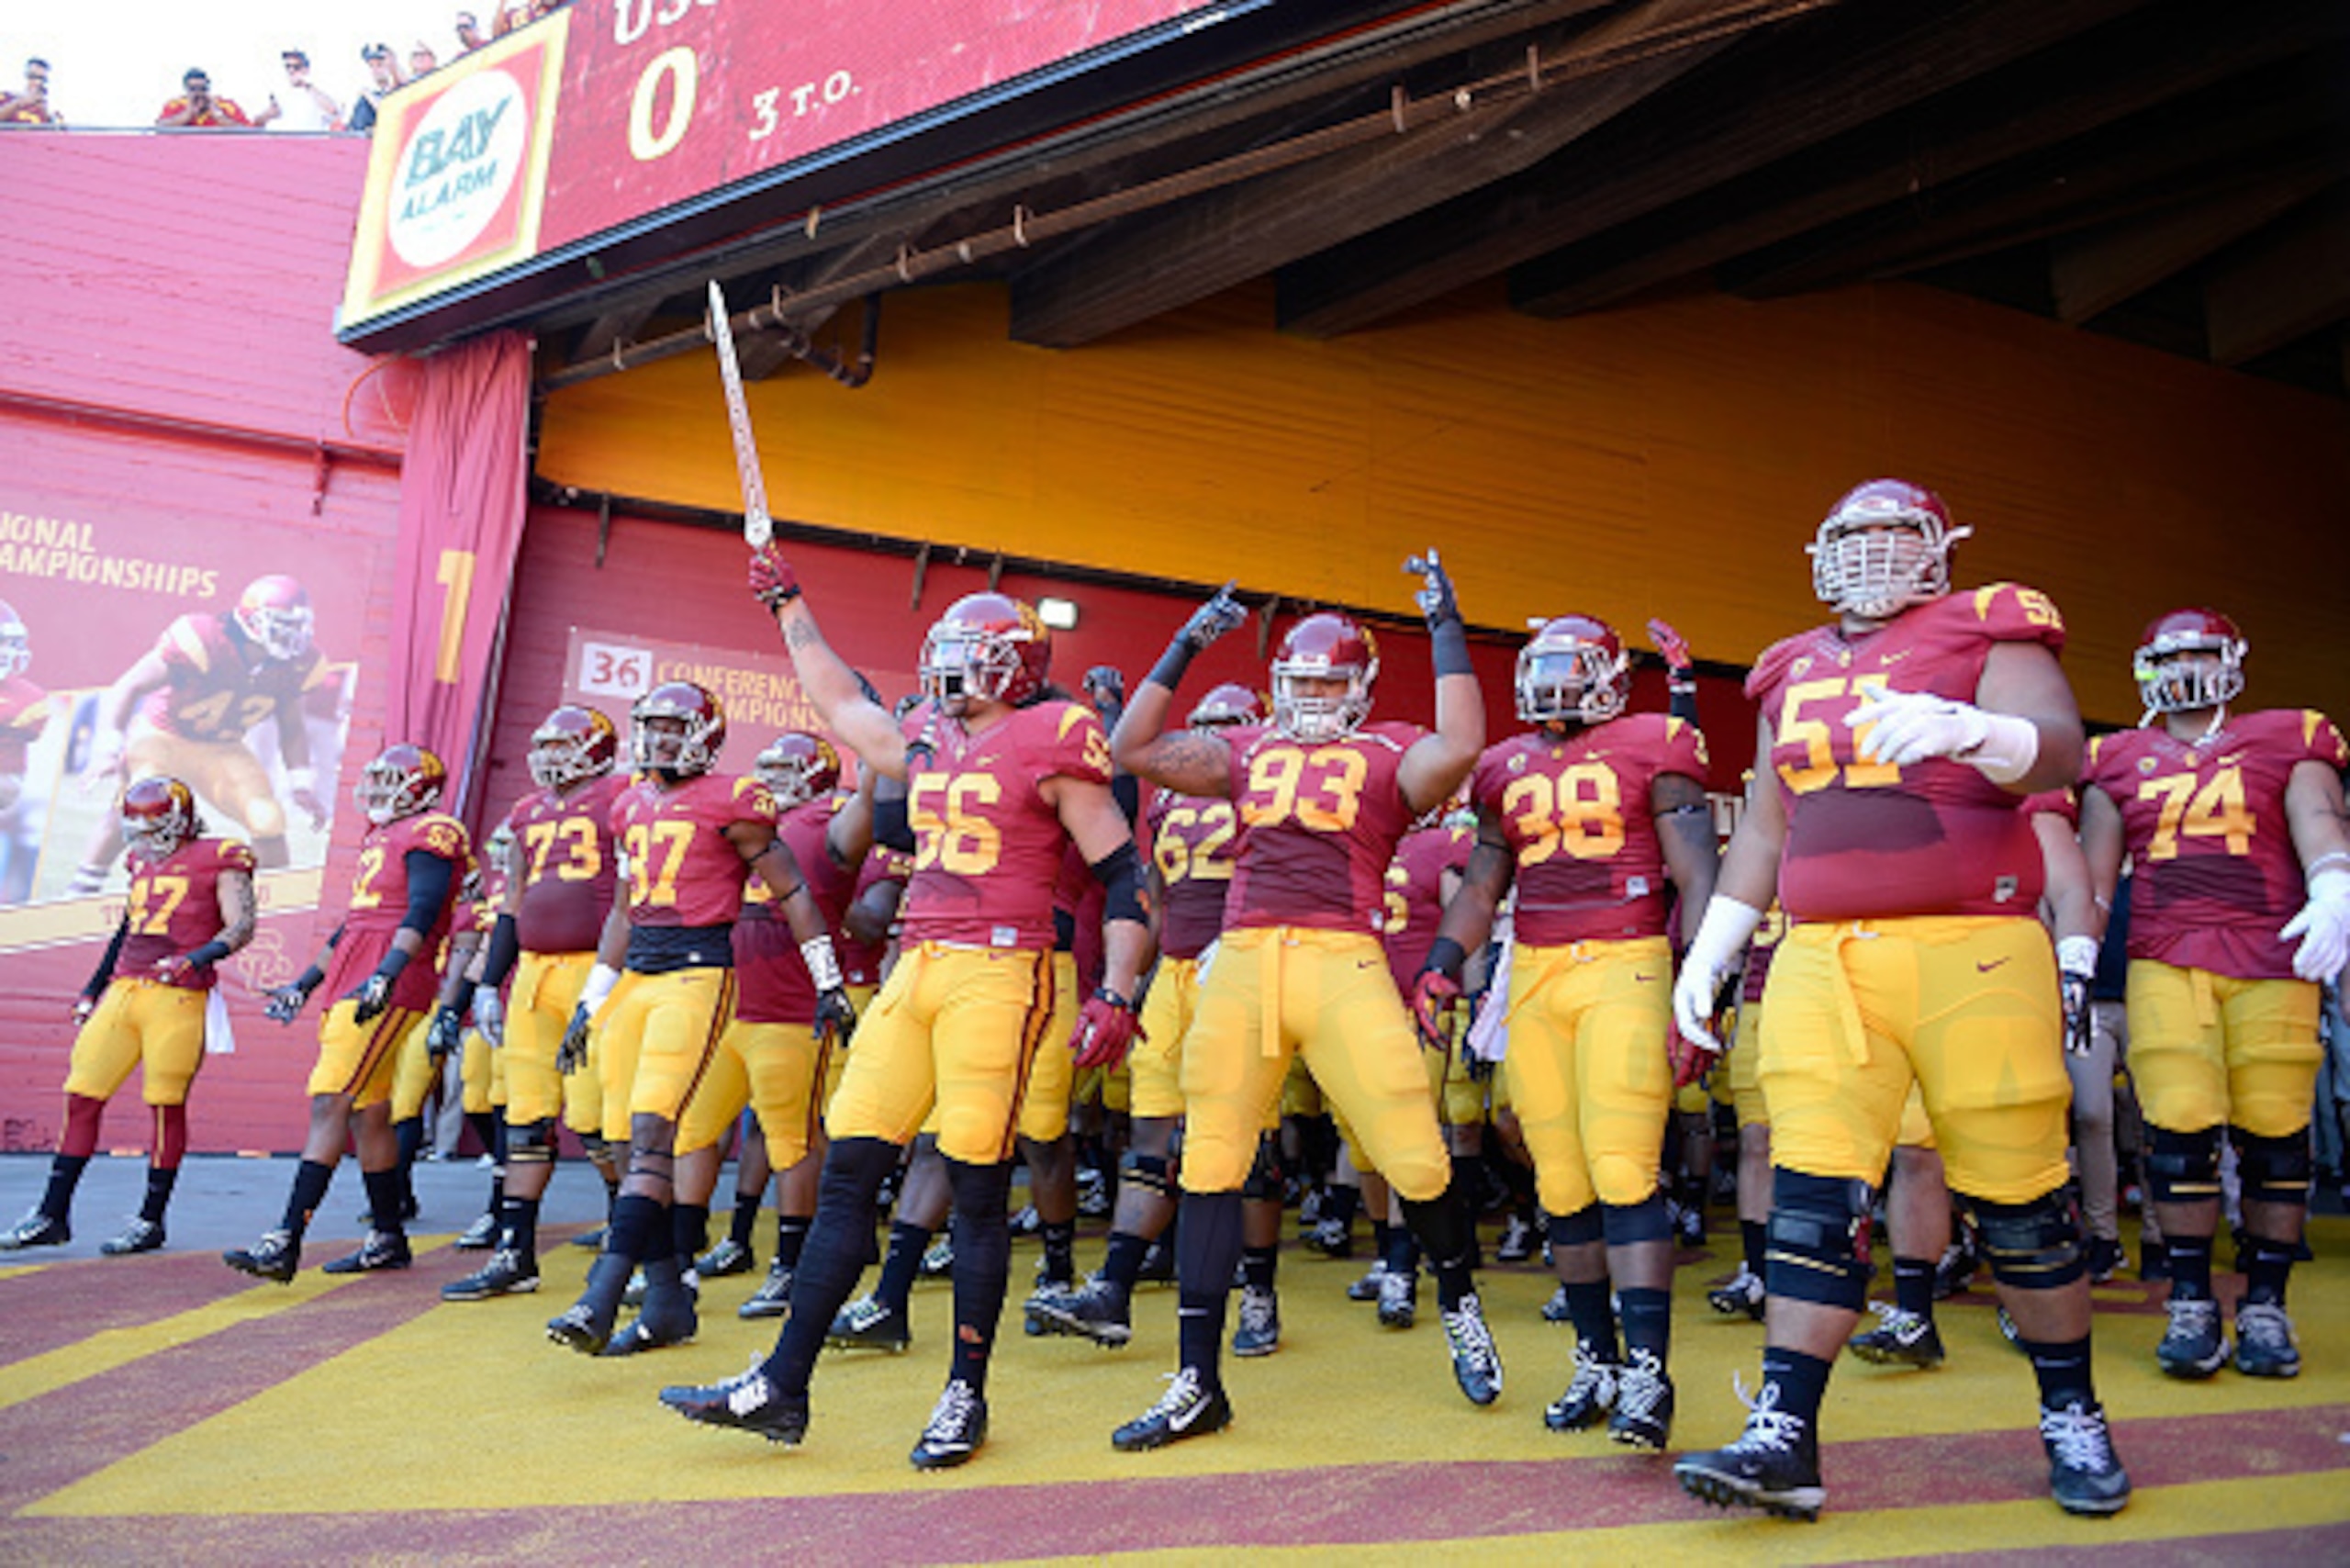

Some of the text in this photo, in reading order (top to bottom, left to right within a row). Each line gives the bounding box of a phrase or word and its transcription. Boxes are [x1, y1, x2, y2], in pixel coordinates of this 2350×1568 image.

[404, 95, 512, 188] BAY
[628, 46, 699, 162] 0
[749, 86, 779, 140] 3
[398, 158, 499, 222] ALARM
[591, 651, 641, 688] 36
[1776, 671, 1903, 795] 51
[908, 772, 1002, 875] 56
[1241, 746, 1369, 832] 93
[1502, 761, 1626, 868] 38
[2137, 765, 2257, 862] 74
[526, 815, 602, 883] 73
[1154, 801, 1238, 886] 62
